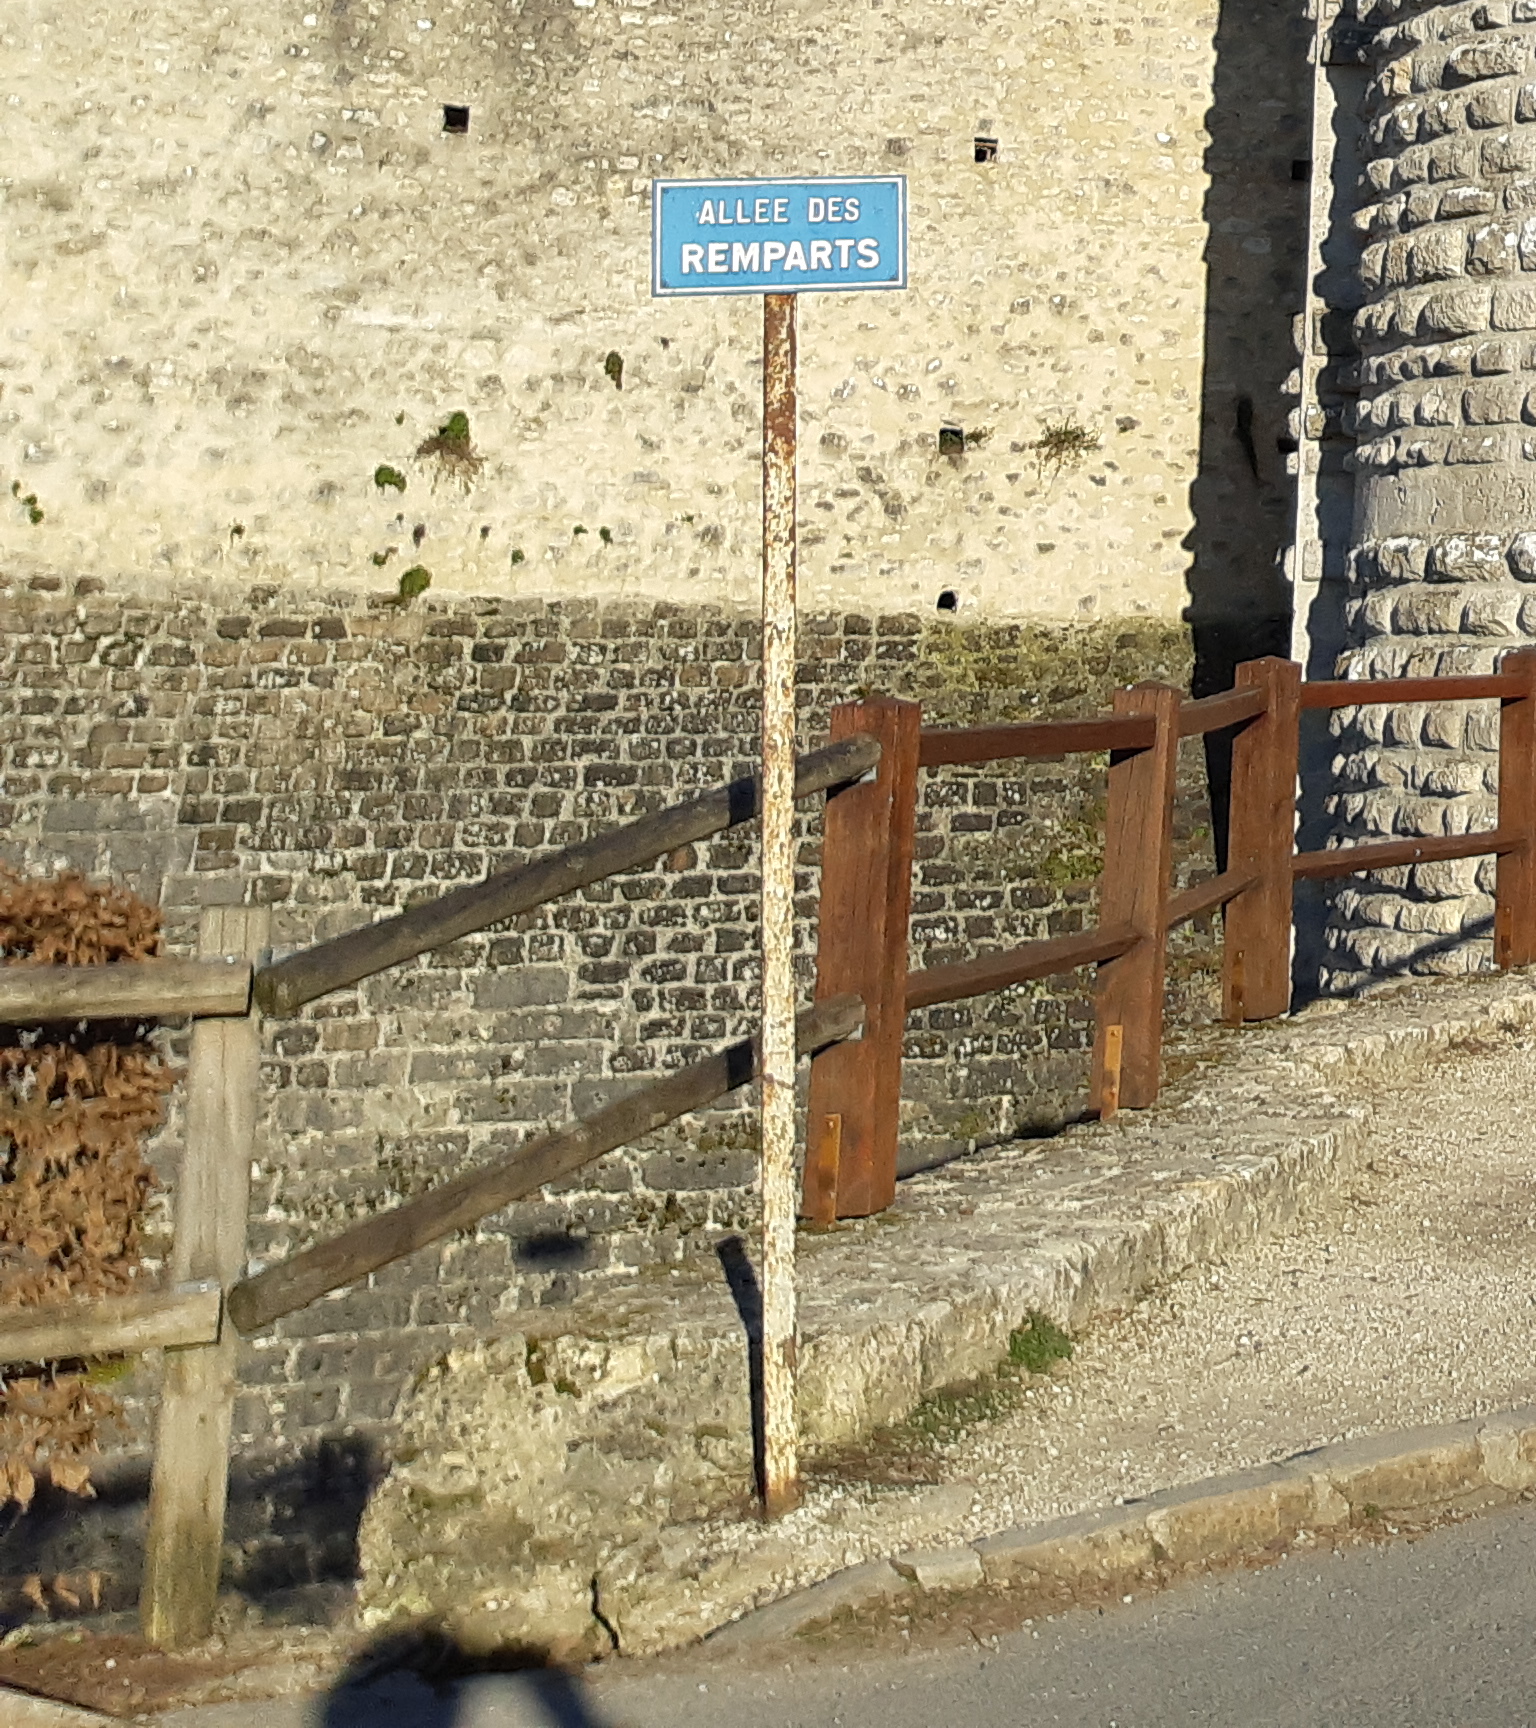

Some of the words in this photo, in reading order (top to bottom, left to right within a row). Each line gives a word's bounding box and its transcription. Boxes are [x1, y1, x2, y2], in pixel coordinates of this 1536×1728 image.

[698, 198, 790, 225] ALLEE
[807, 197, 860, 223] DES
[681, 237, 880, 274] REMPARTS
